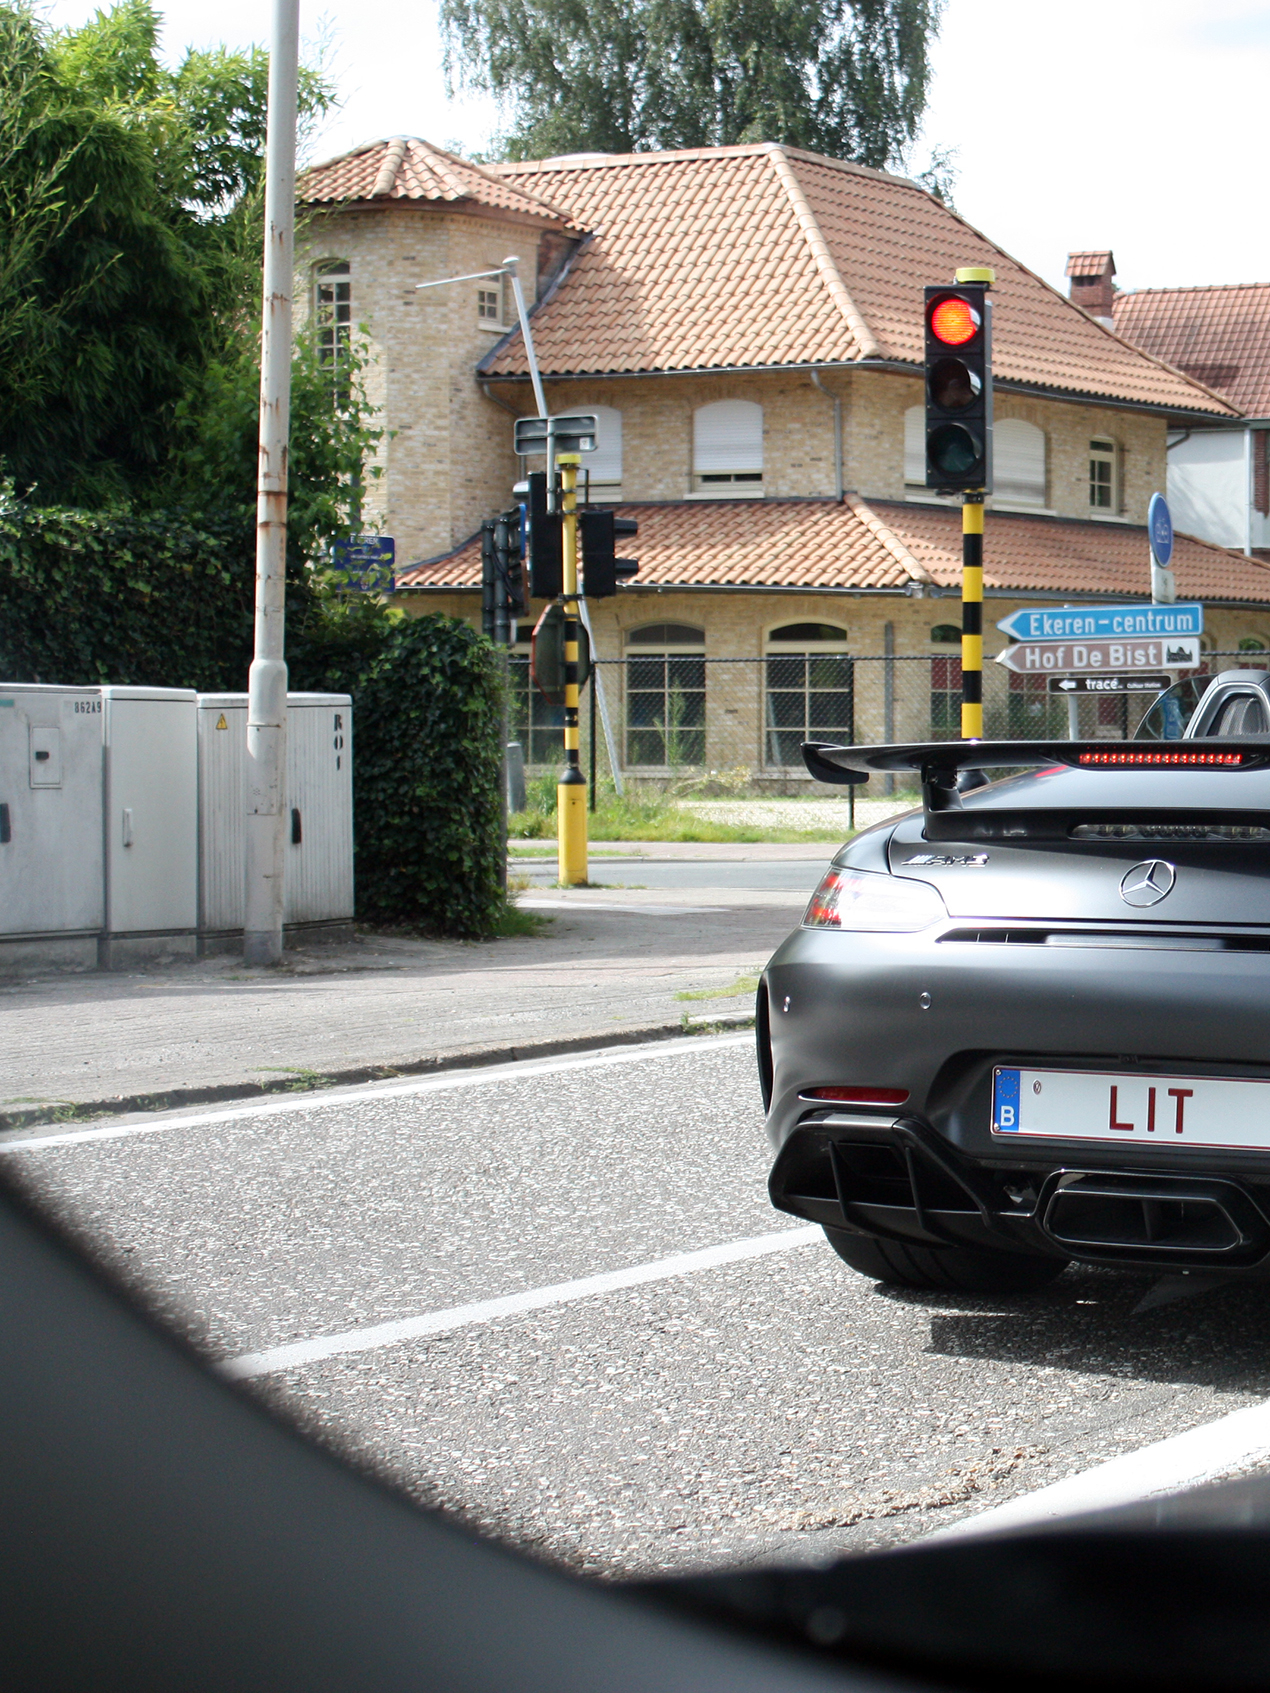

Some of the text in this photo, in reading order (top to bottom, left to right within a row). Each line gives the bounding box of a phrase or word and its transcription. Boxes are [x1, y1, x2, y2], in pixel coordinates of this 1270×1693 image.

[1030, 612, 1193, 636] Ekeren-centrum
[1025, 645, 1157, 669] Hof De Bist
[1085, 677, 1118, 690] tracé
[1001, 1105, 1015, 1127] B
[1109, 1085, 1194, 1134] LIT
